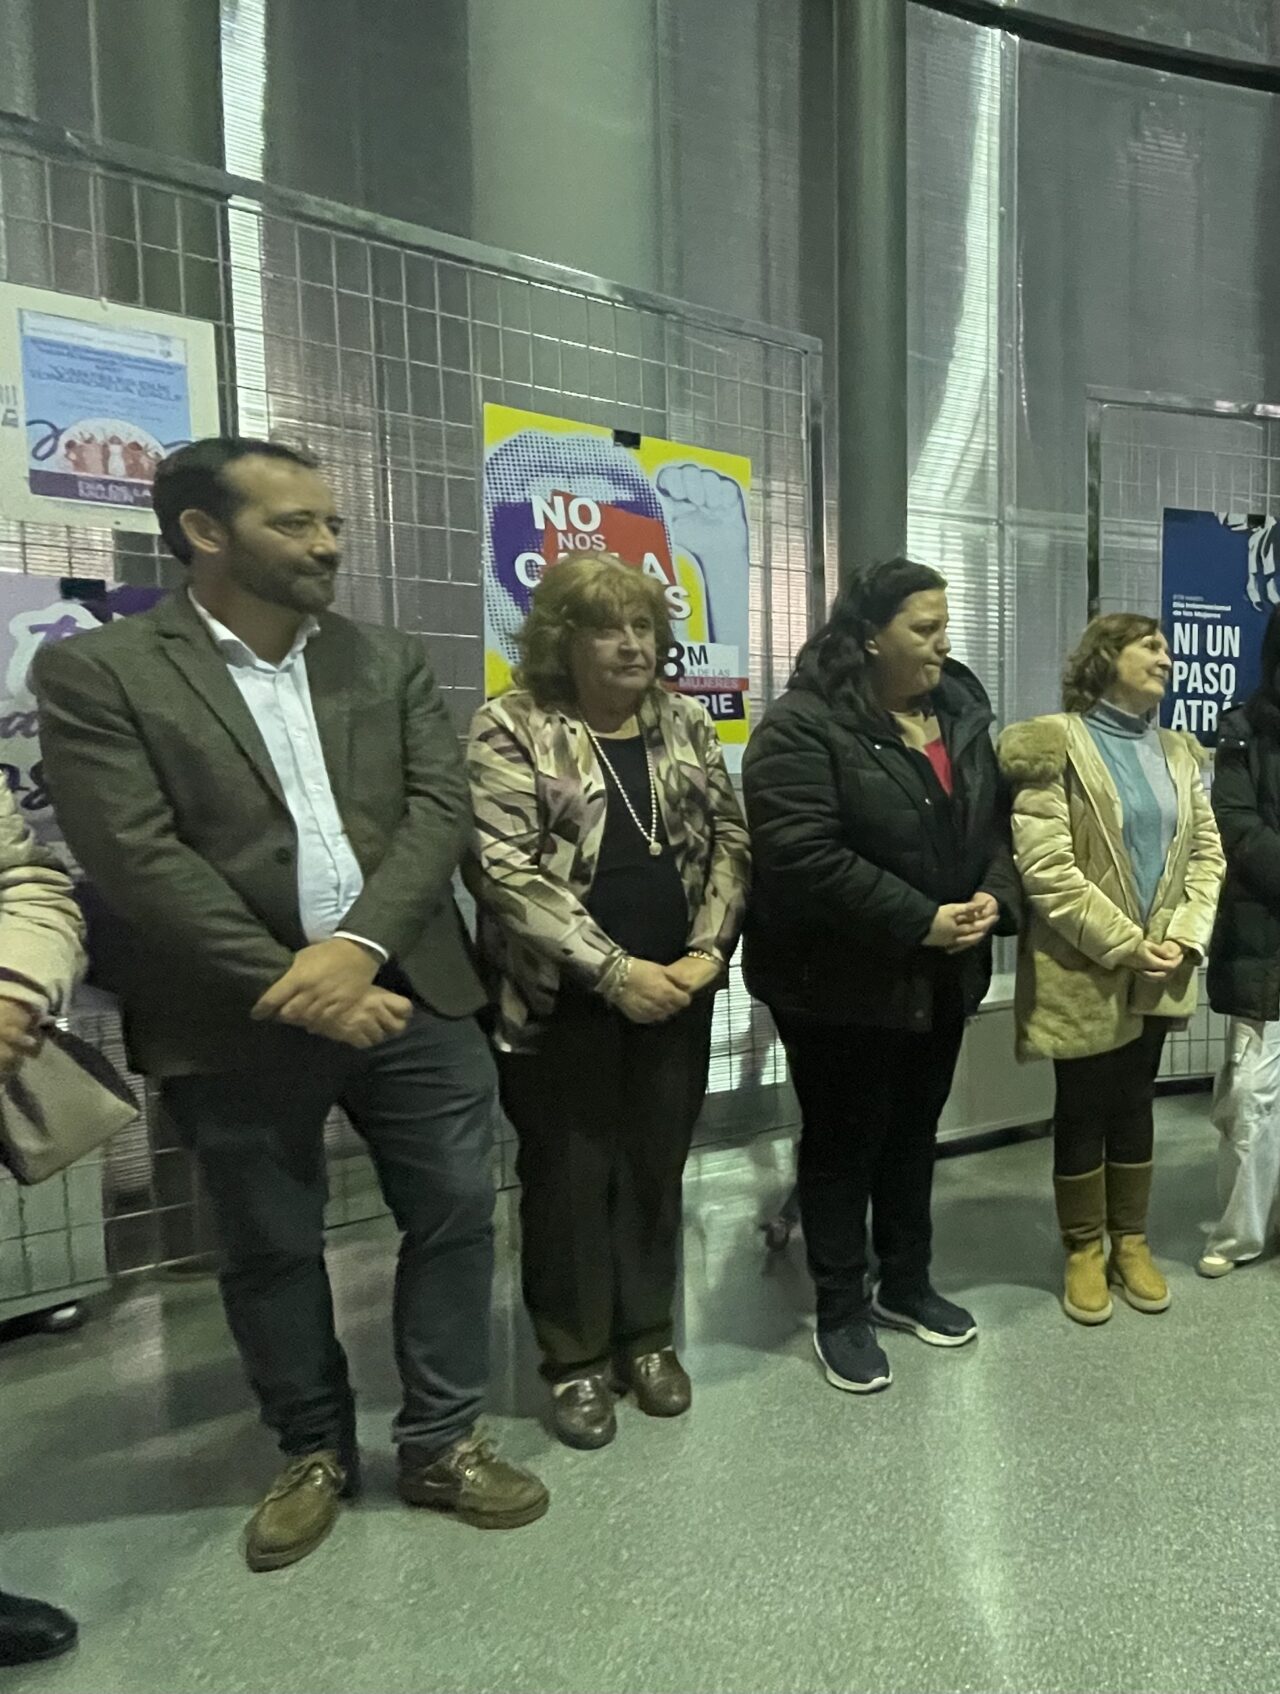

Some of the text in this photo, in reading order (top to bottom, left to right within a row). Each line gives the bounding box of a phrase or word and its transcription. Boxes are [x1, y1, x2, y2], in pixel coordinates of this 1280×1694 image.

[532, 495, 601, 532] NO
[557, 532, 606, 550] NOS
[1173, 622, 1240, 657] NI UN
[1172, 660, 1236, 695] PASO
